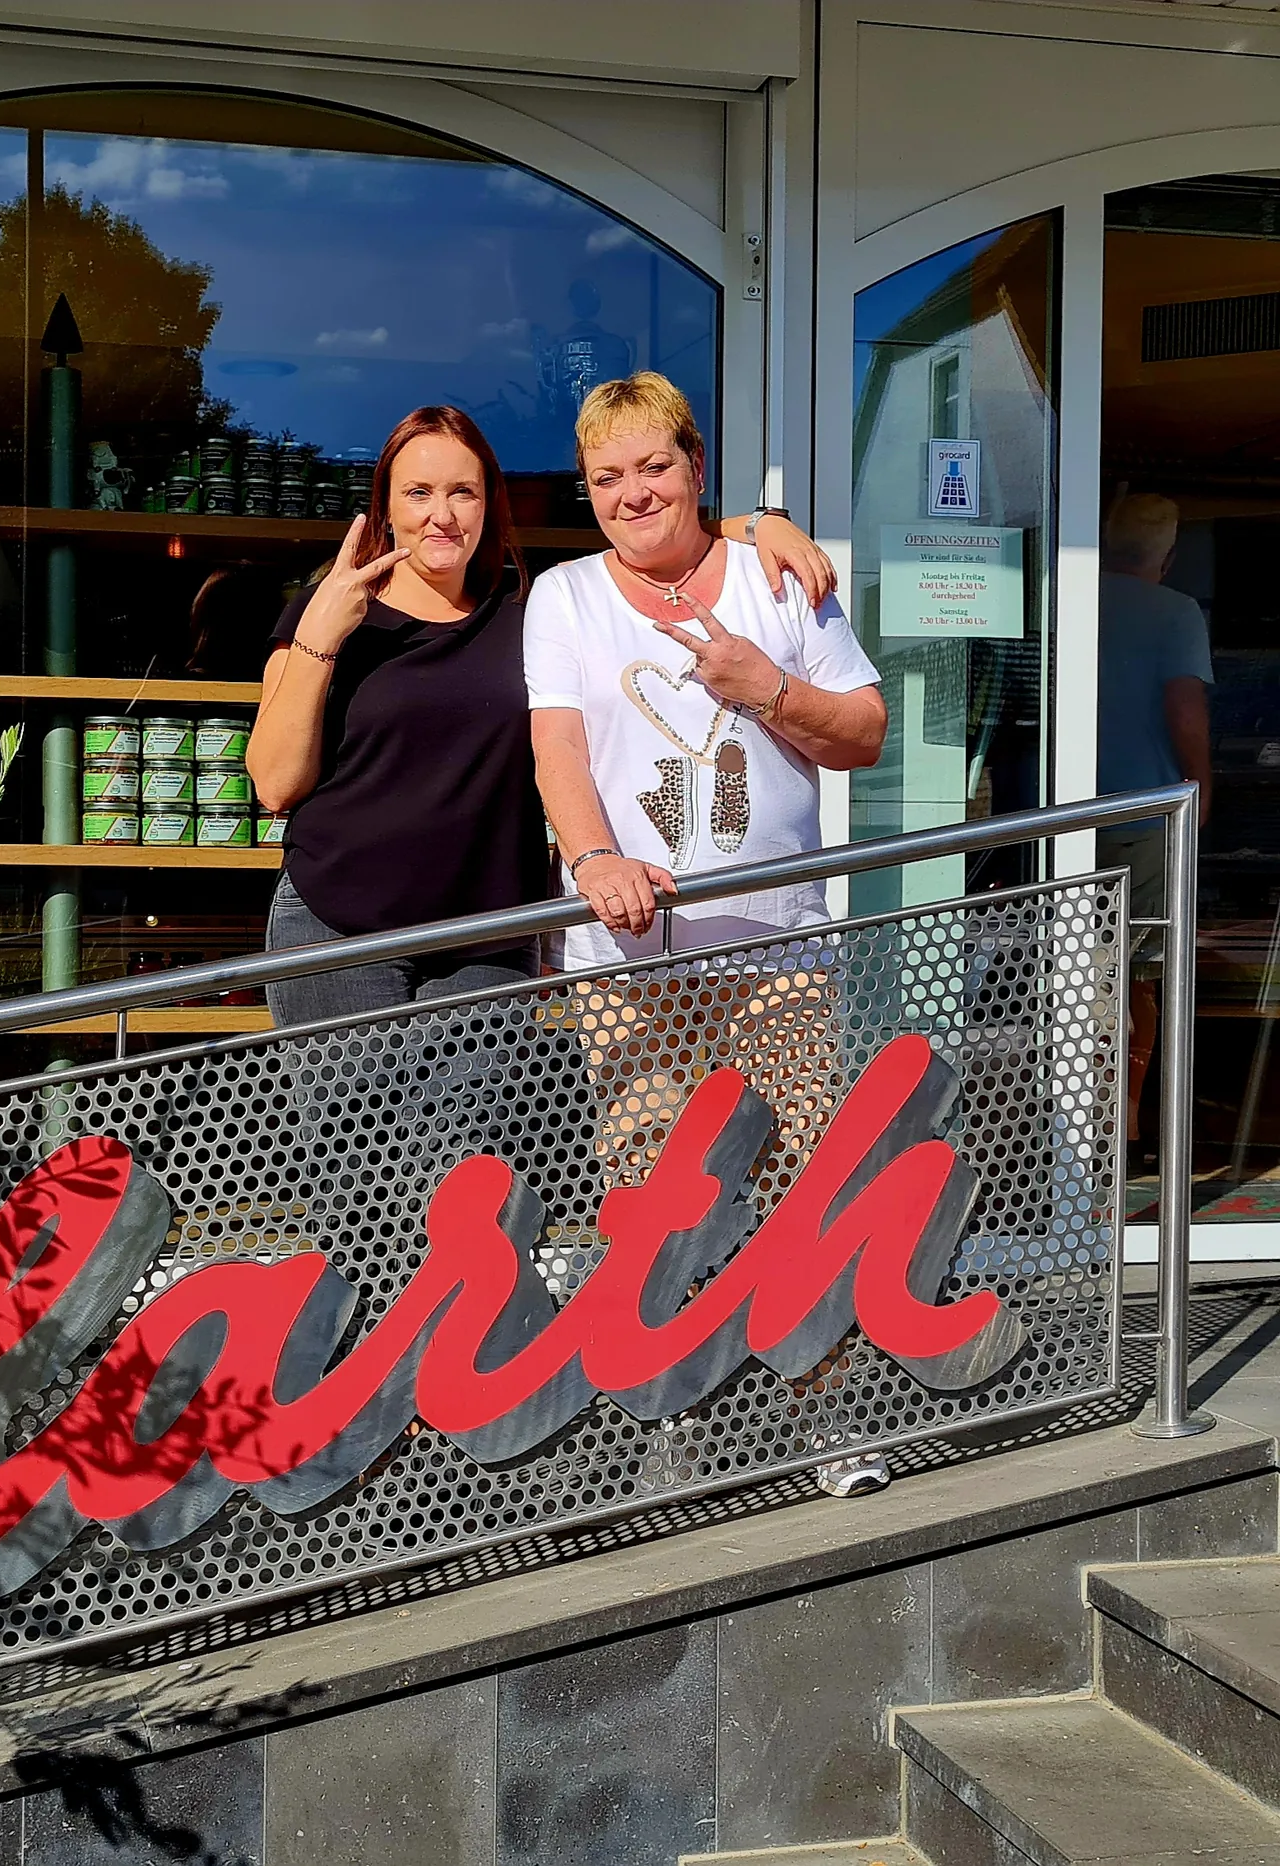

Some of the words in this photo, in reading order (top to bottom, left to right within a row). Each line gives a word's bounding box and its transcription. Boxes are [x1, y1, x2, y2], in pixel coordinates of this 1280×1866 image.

[938, 450, 971, 461] girocard
[904, 532, 1000, 547] ÖFFNUNGSZEITEN
[920, 553, 934, 561] Wir
[935, 553, 950, 561] sind
[951, 554, 963, 562] für
[921, 572, 949, 581] Montag
[949, 572, 960, 580] bis
[961, 573, 986, 582] Freitag
[935, 582, 949, 590] Uhr
[974, 582, 988, 591] Uhr
[931, 591, 976, 601] durchgehend
[939, 607, 969, 616] Samstag
[935, 617, 949, 625] Uhr
[974, 617, 989, 626] Uhr
